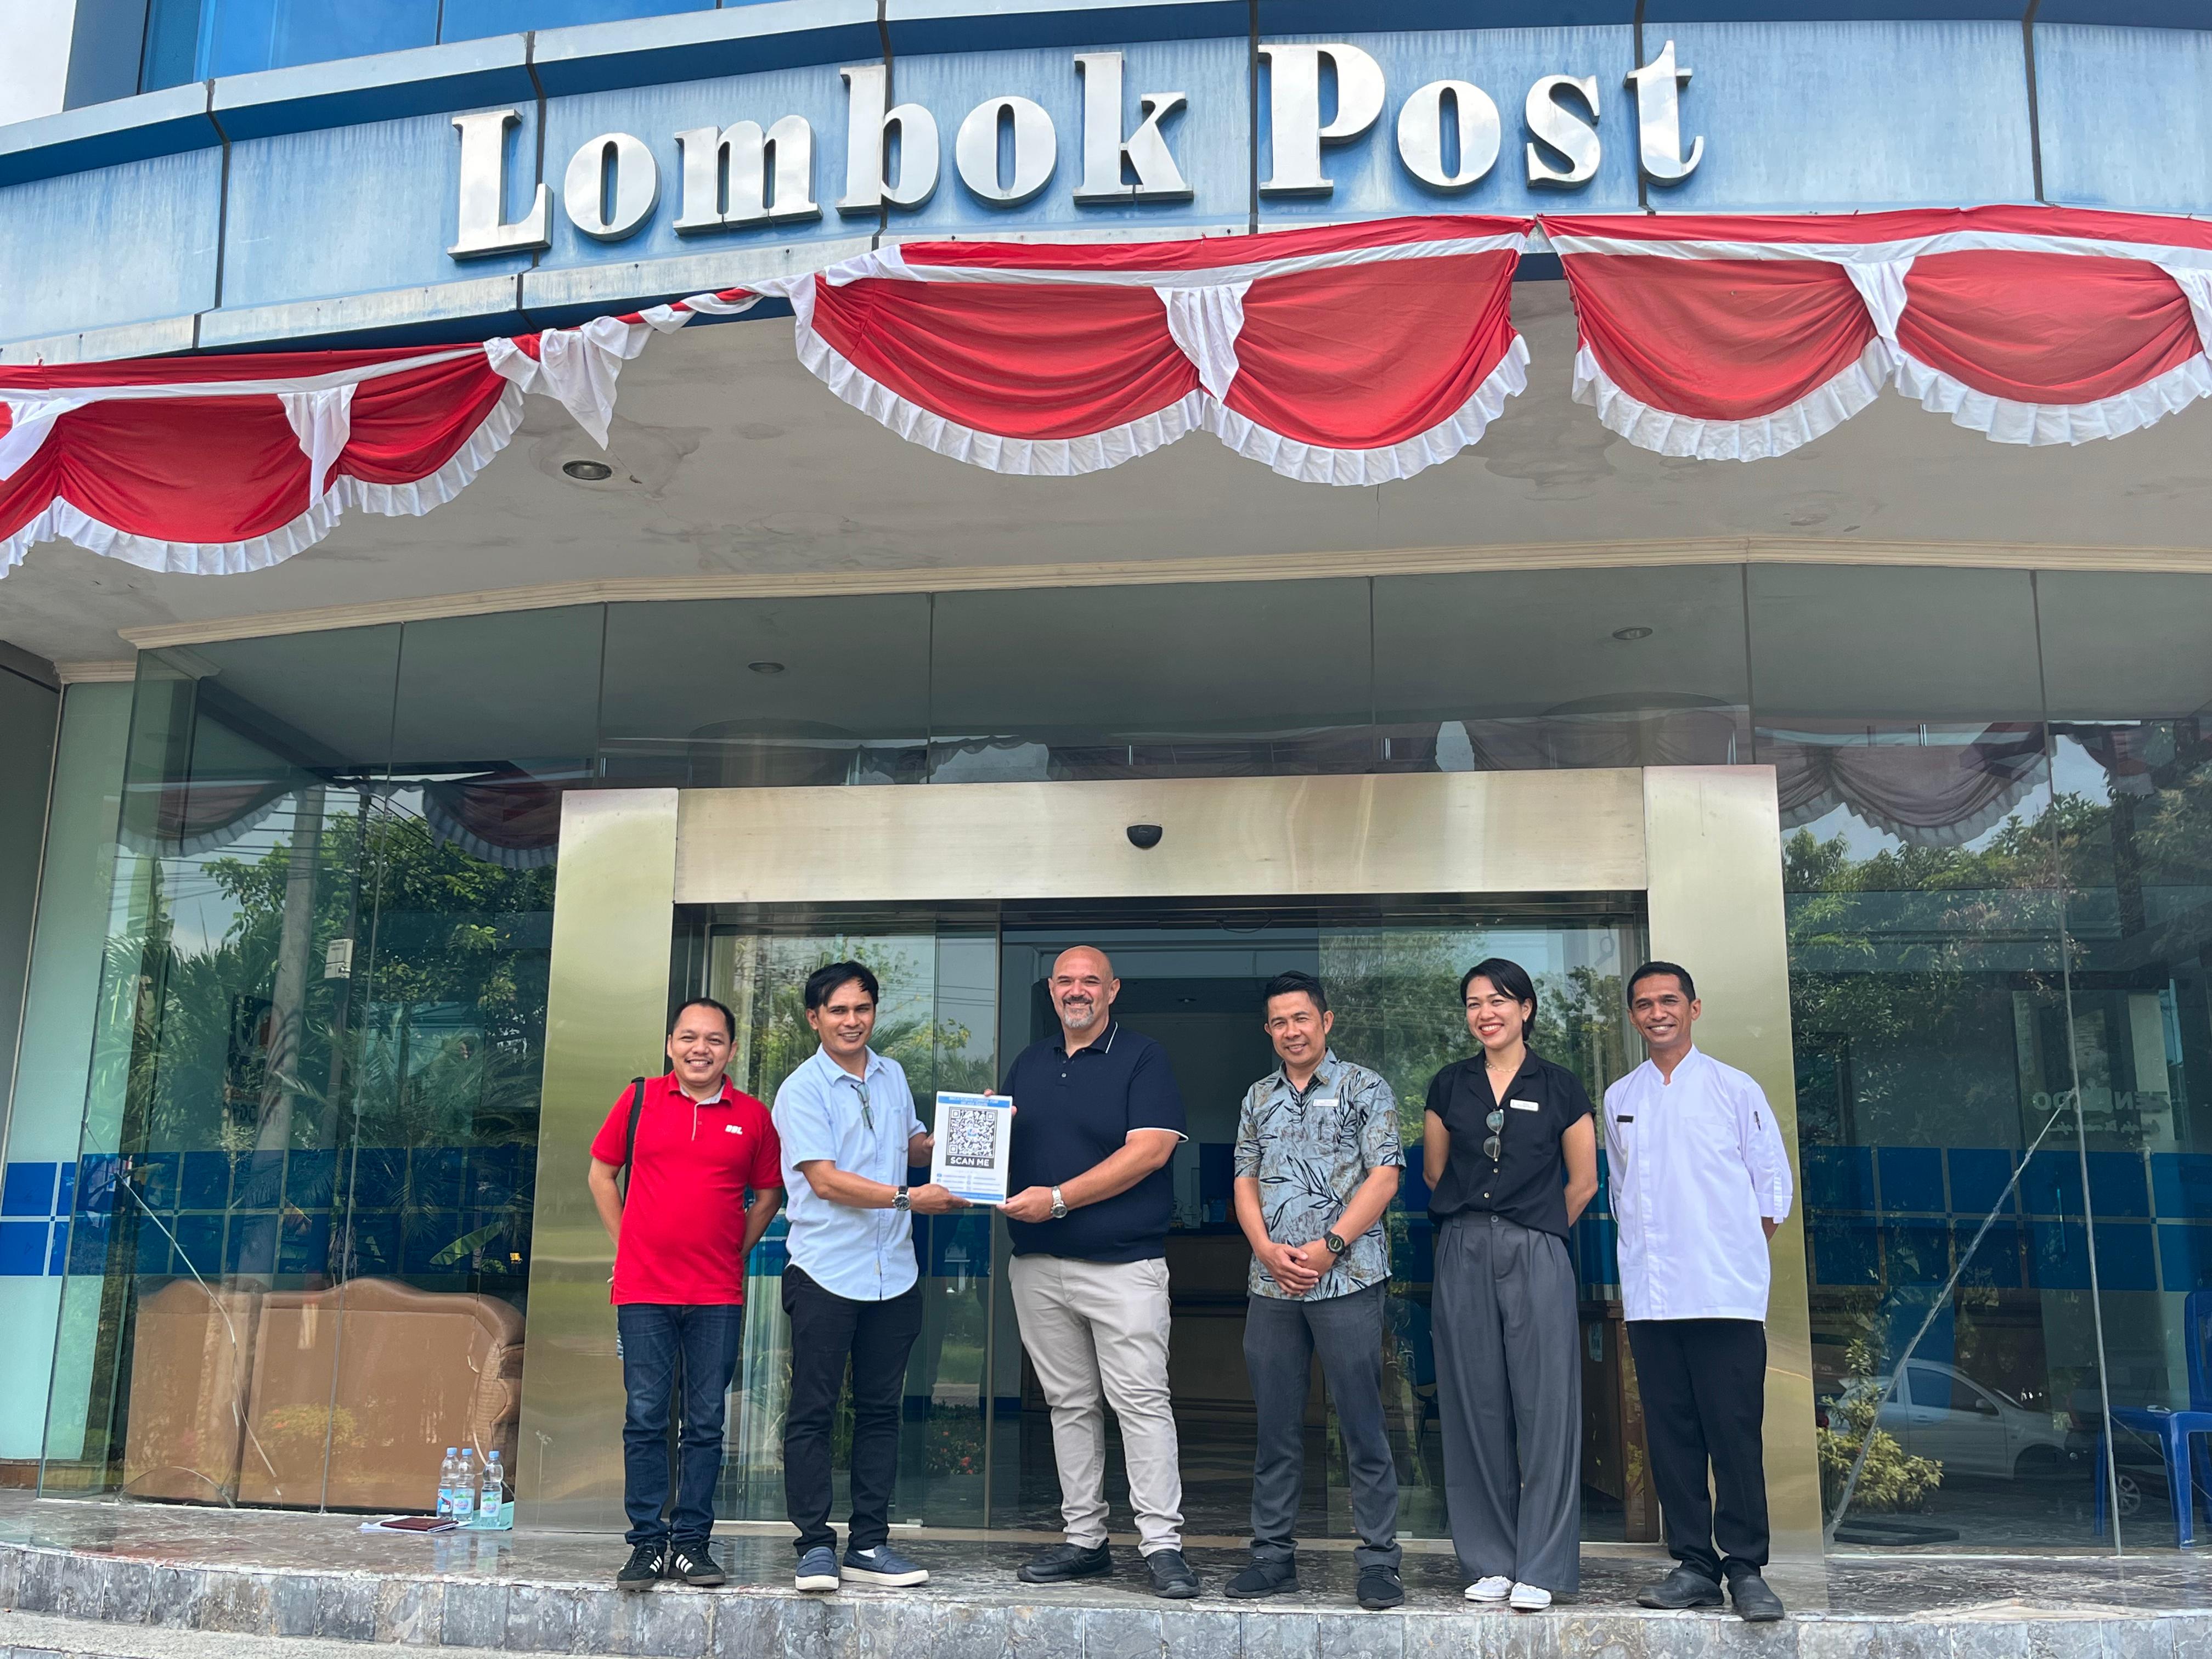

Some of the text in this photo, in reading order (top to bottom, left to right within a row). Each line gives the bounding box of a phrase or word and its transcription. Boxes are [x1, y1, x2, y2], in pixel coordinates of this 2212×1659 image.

[447, 40, 1704, 261] Lombok Post
[950, 1156, 990, 1166] SCAN ME
